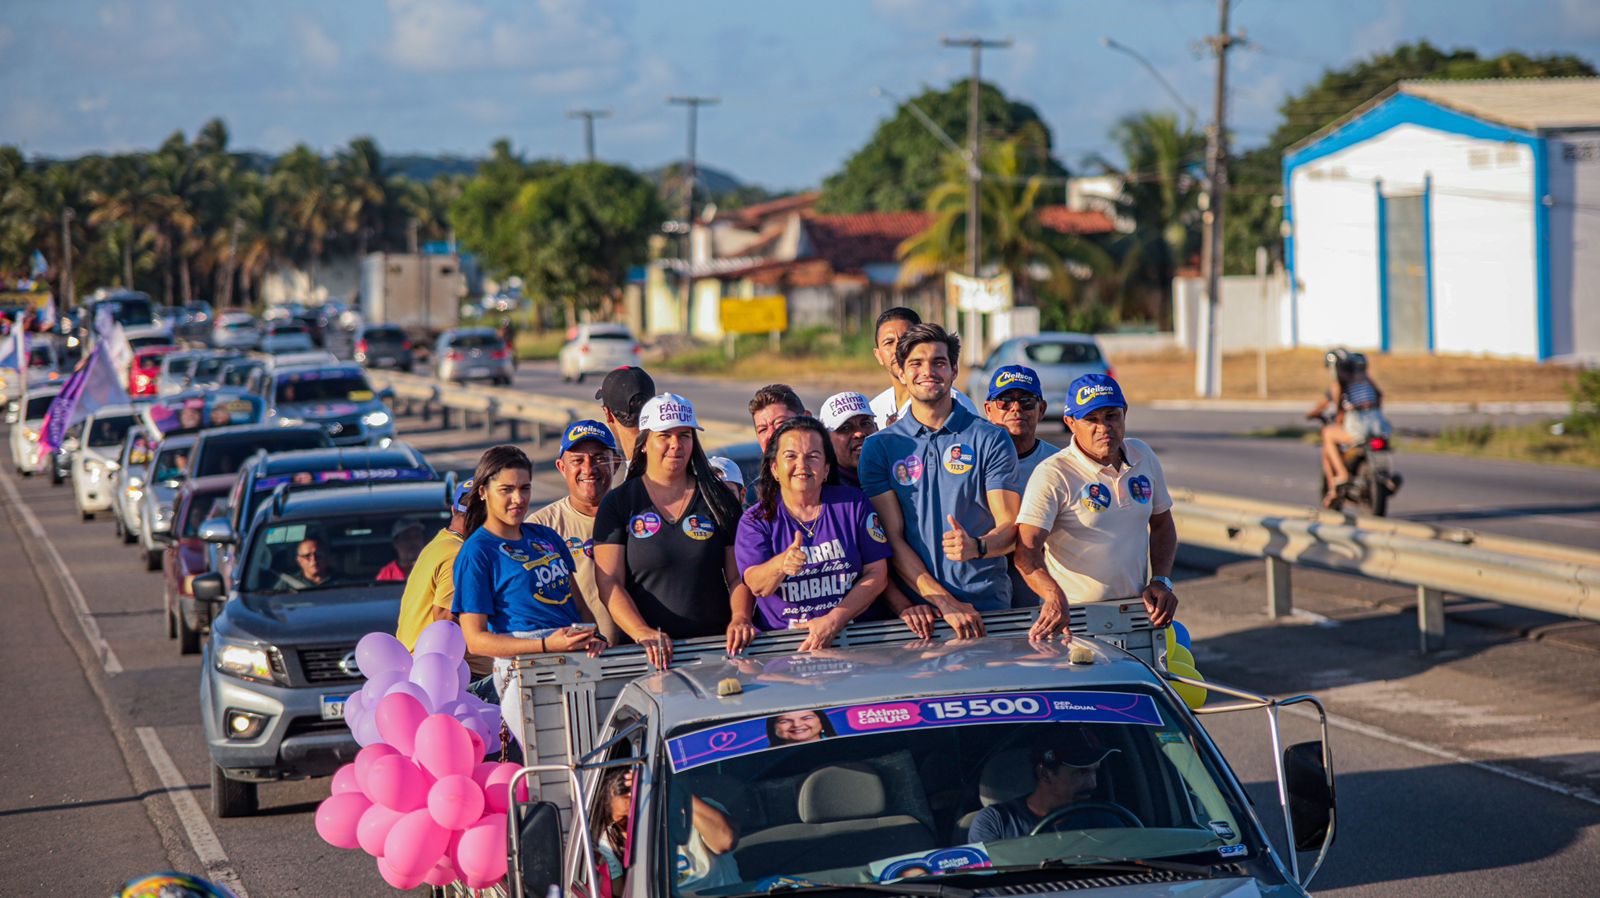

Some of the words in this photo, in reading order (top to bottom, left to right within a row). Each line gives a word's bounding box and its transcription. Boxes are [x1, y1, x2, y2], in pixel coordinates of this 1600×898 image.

[1004, 372, 1033, 382] Neilson
[1084, 385, 1114, 396] Neilson
[950, 463, 965, 471] 1133
[801, 539, 846, 565] ARRA
